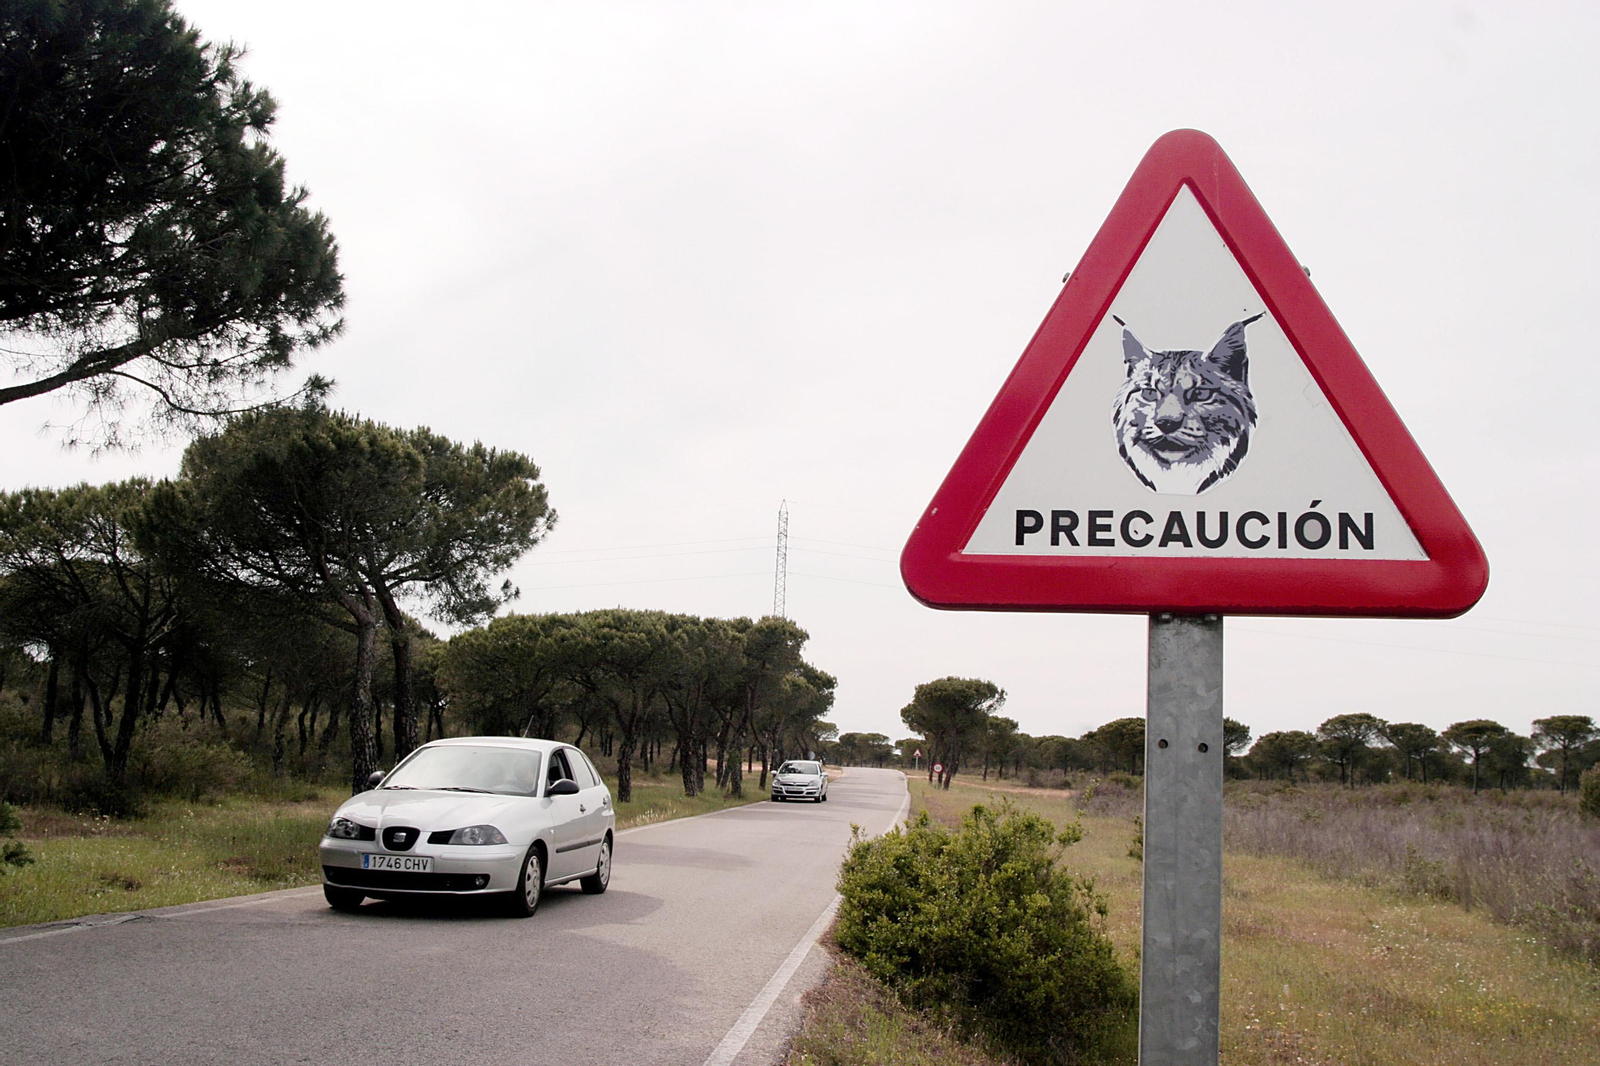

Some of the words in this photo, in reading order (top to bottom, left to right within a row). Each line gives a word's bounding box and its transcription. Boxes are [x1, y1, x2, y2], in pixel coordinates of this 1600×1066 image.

[1015, 500, 1374, 550] PRECAUCIÓN
[372, 856, 401, 869] 1746
[404, 858, 428, 871] CHV
